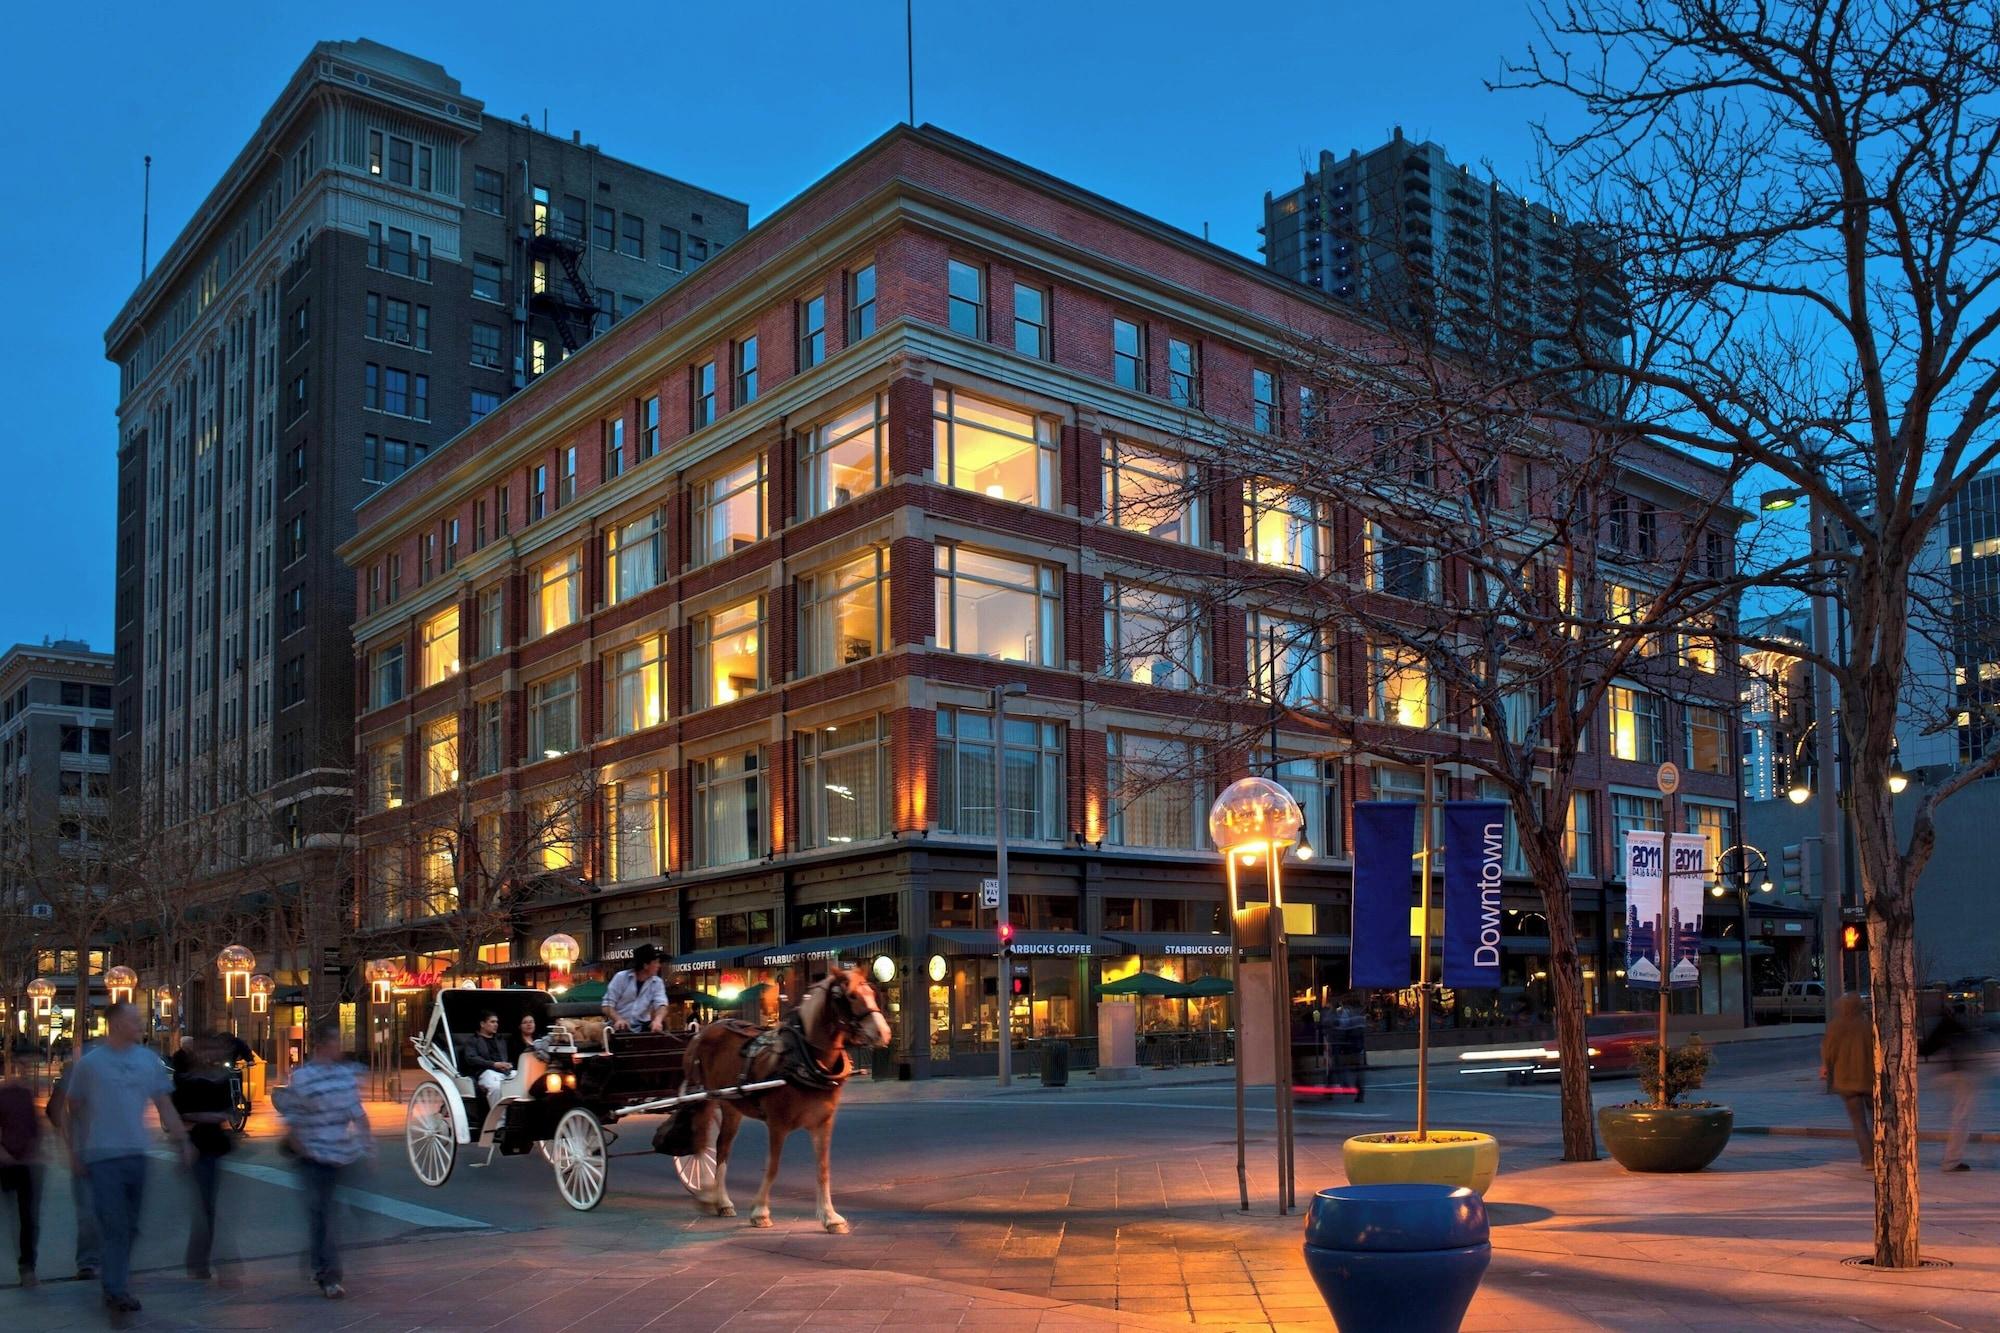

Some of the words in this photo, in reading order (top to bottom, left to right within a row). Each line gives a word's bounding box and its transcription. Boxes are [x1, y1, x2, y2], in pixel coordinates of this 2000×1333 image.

[1632, 845, 1661, 869] 2011
[1675, 848, 1703, 871] 2011
[985, 881, 998, 889] ONE
[1473, 823, 1504, 967] Downtown
[601, 948, 634, 961] ARBUCKS
[1009, 944, 1055, 954] ARBUCKS
[1056, 944, 1092, 954] COFFEE
[1165, 945, 1213, 955] STARBUCKS
[763, 953, 806, 966] STARBUCKS
[806, 950, 835, 961] COFFEE
[692, 960, 716, 971] COFFEE
